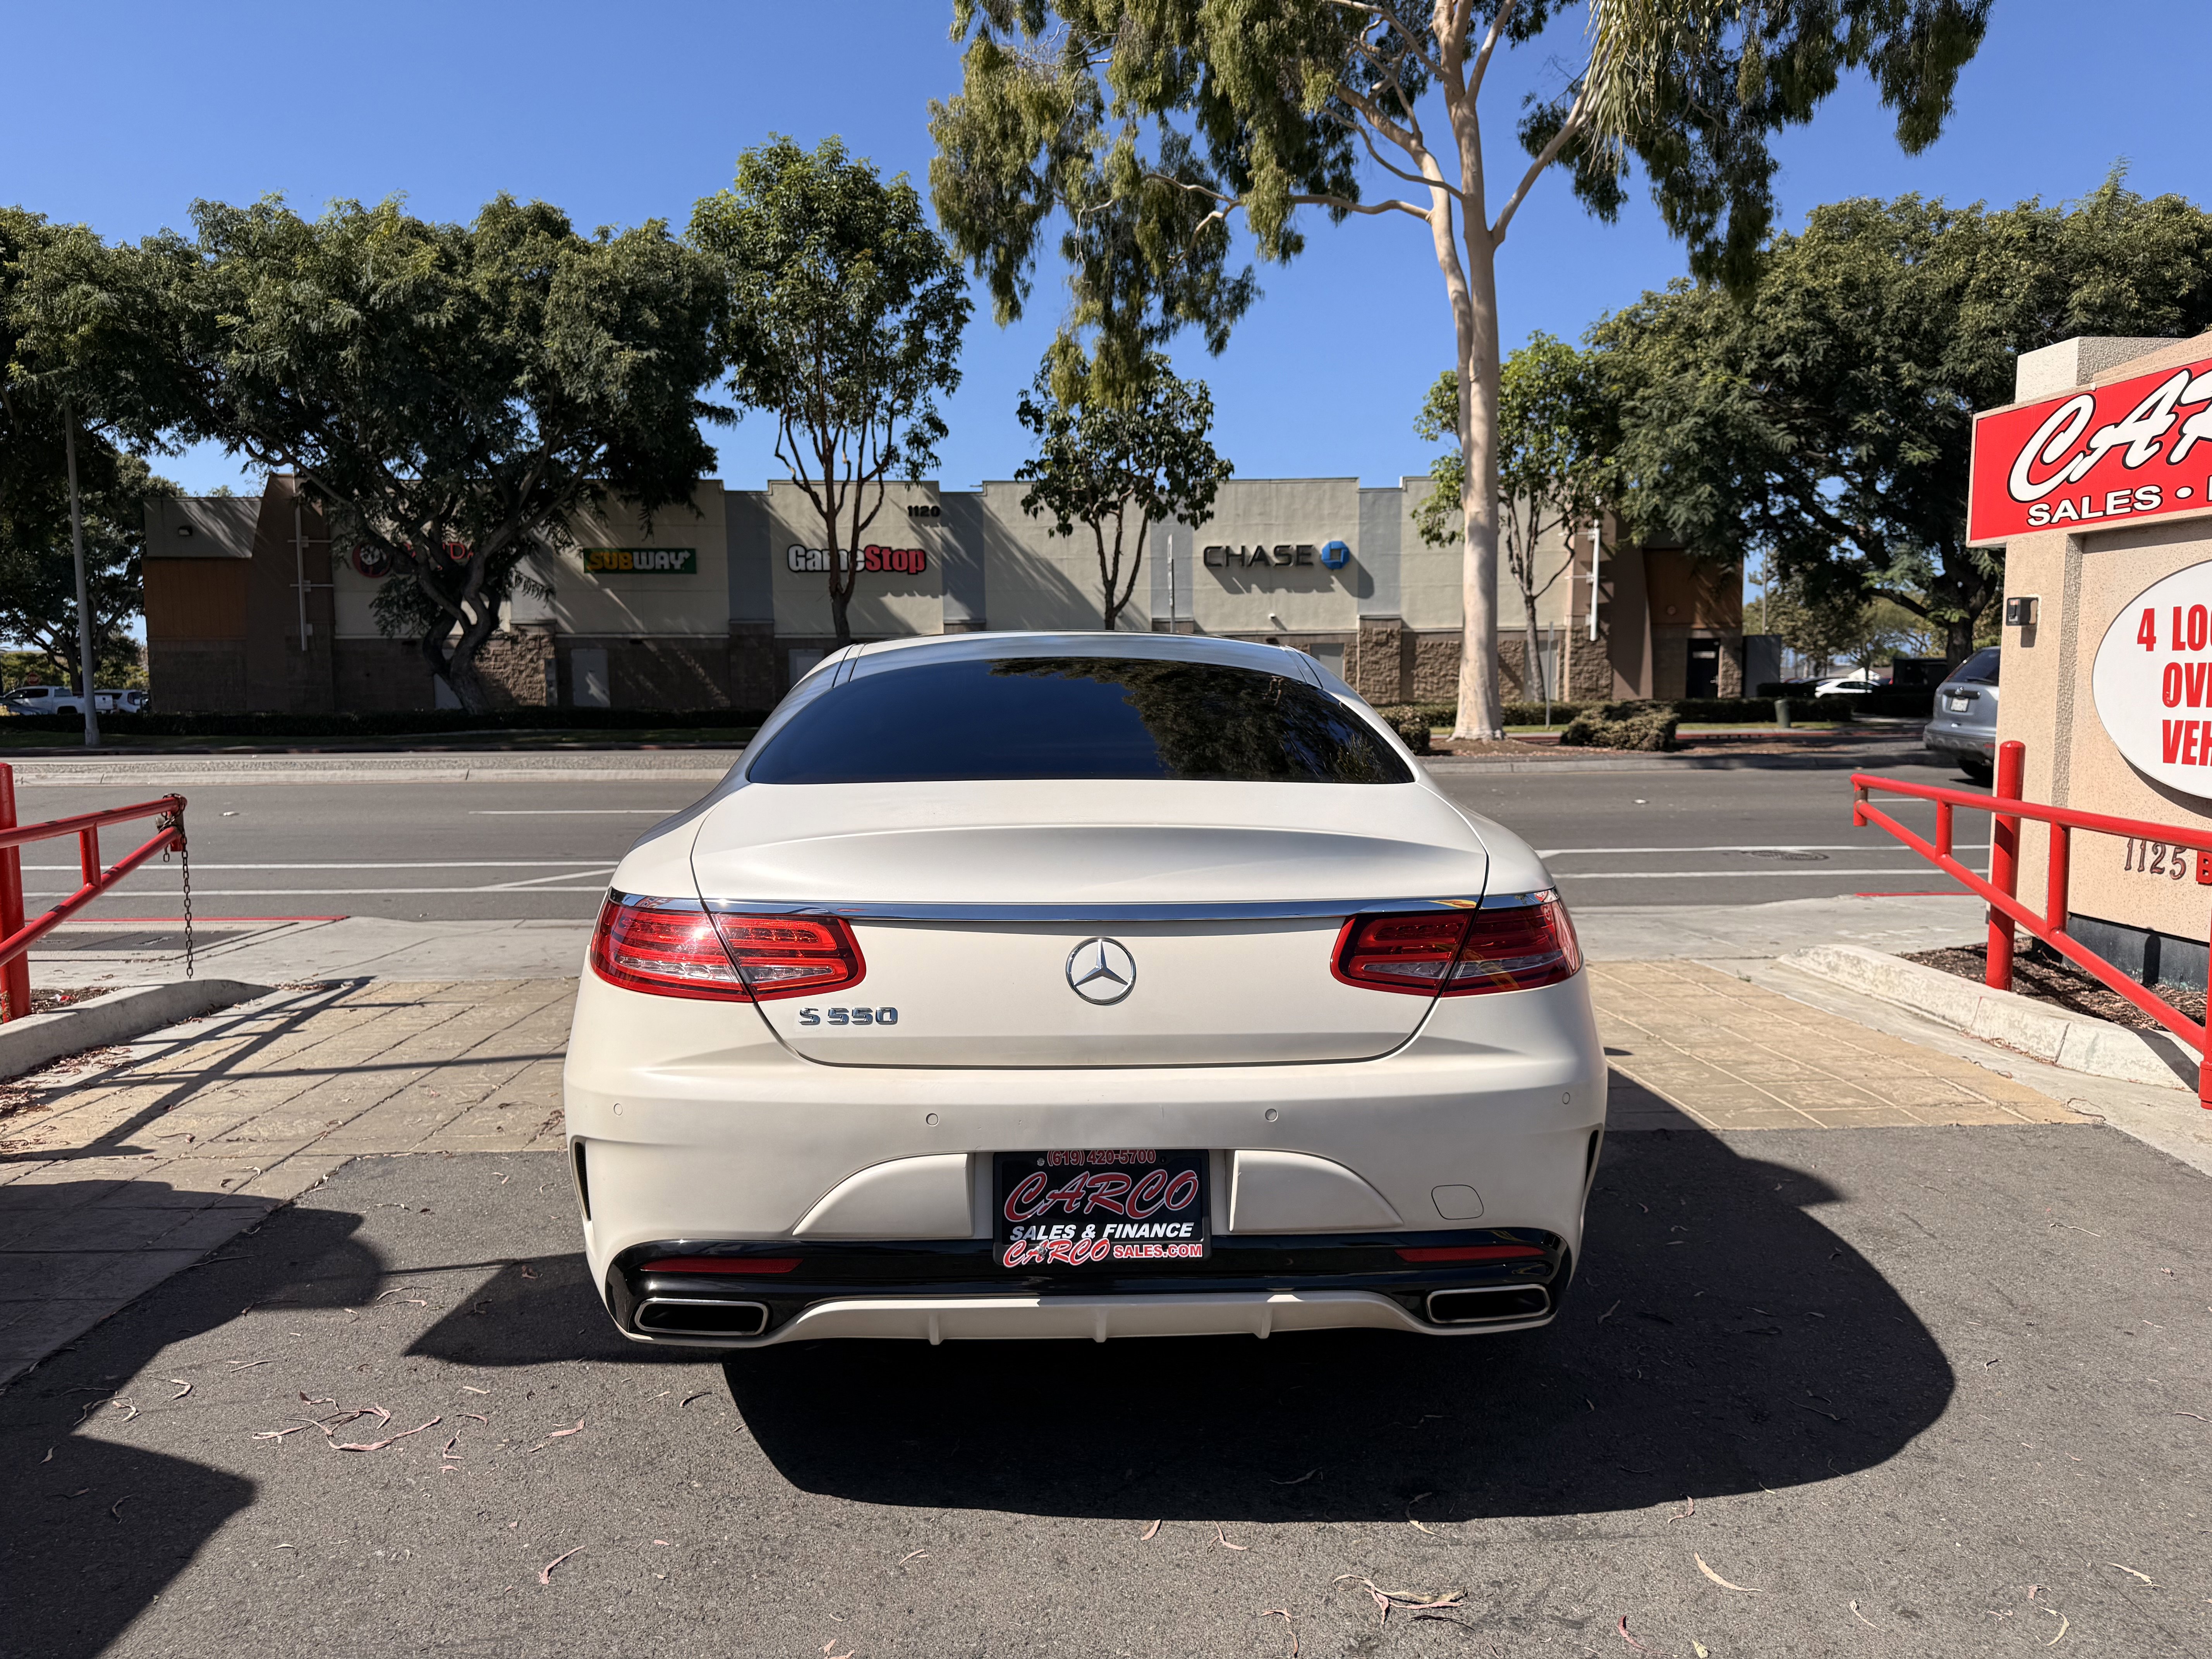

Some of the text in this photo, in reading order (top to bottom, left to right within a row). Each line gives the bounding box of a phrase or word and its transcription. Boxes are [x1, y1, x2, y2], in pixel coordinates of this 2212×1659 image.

[907, 505, 941, 517] 1120
[2027, 485, 2163, 527] SALES
[586, 551, 691, 570] SUBWAY
[1204, 544, 1315, 567] CHASE
[2137, 604, 2212, 652] 4 LO
[2124, 837, 2187, 880] 1125
[798, 1007, 898, 1025] S 550
[1047, 1149, 1156, 1166] (619) 420-5700
[1004, 1169, 1199, 1222] CARCO
[1010, 1222, 1195, 1240] SALES & FINANCE
[1003, 1238, 1203, 1268] CARCO SALES.COM
